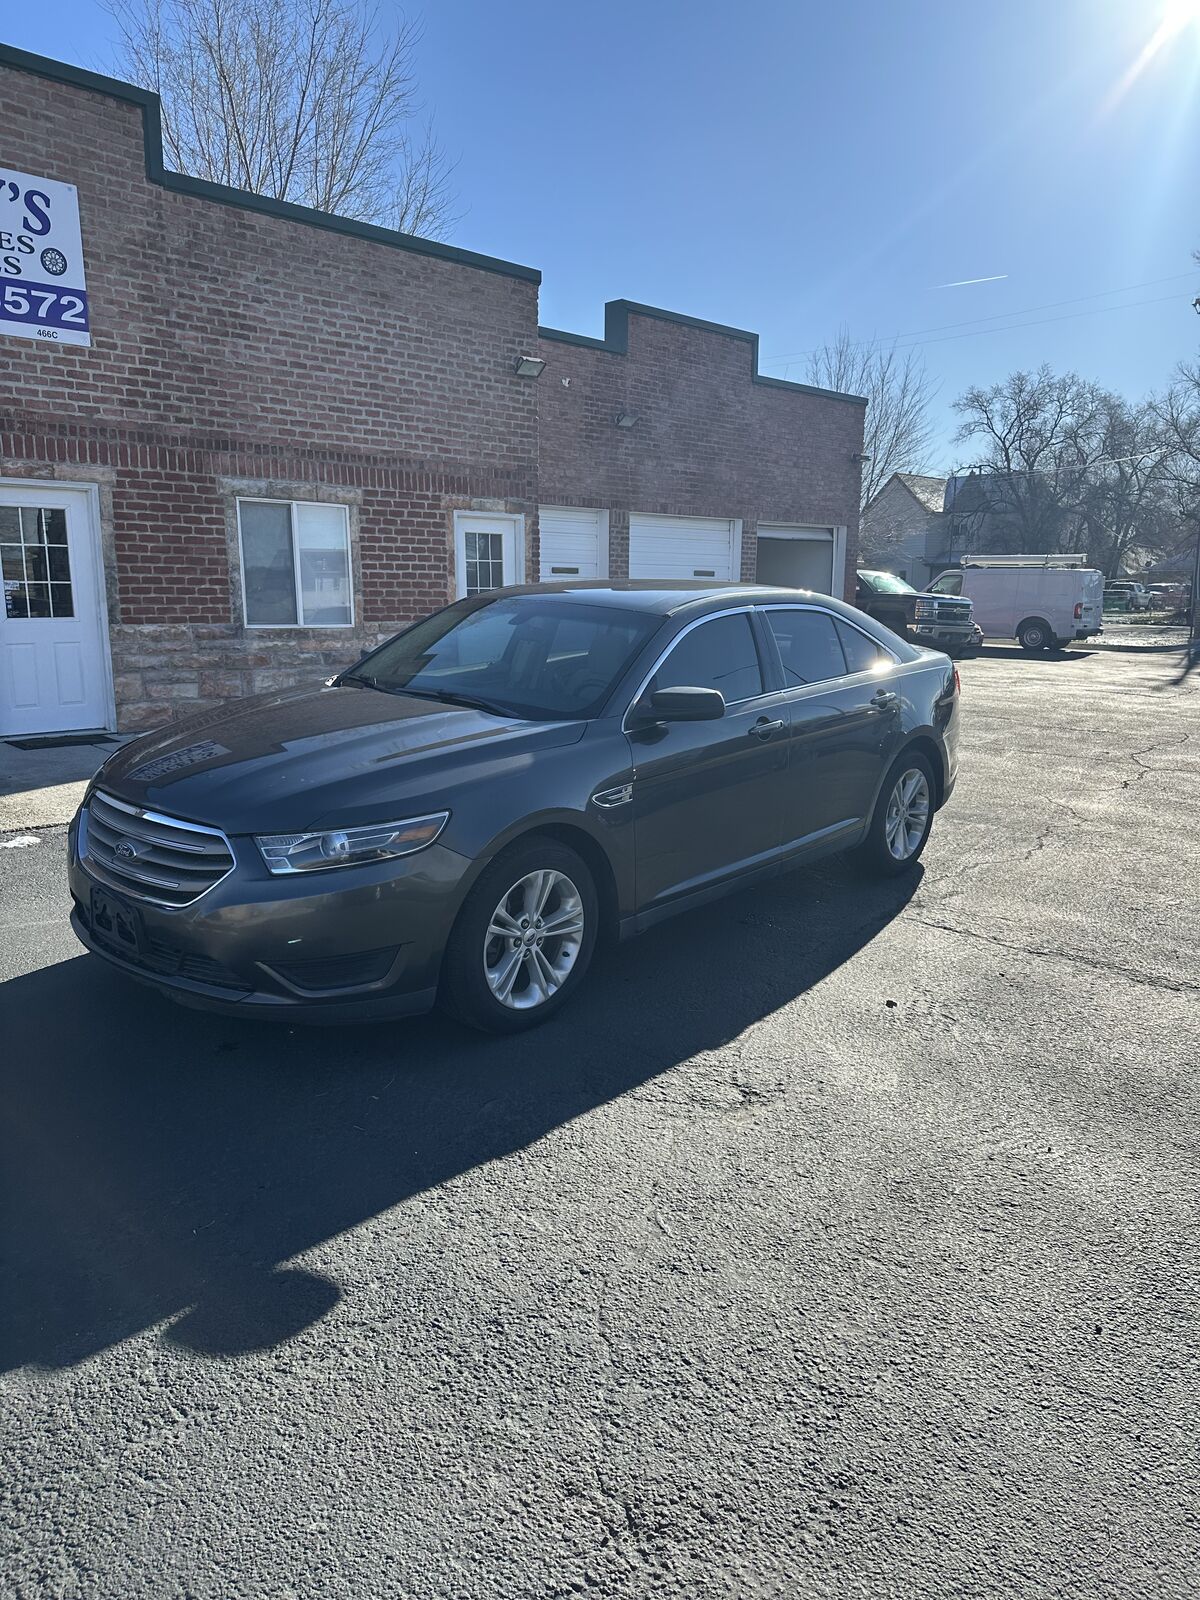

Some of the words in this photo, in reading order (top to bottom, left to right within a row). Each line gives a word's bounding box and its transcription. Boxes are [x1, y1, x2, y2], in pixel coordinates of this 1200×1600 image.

[0, 179, 51, 236] 'S
[0, 285, 86, 324] 572
[37, 329, 58, 339] 466C
